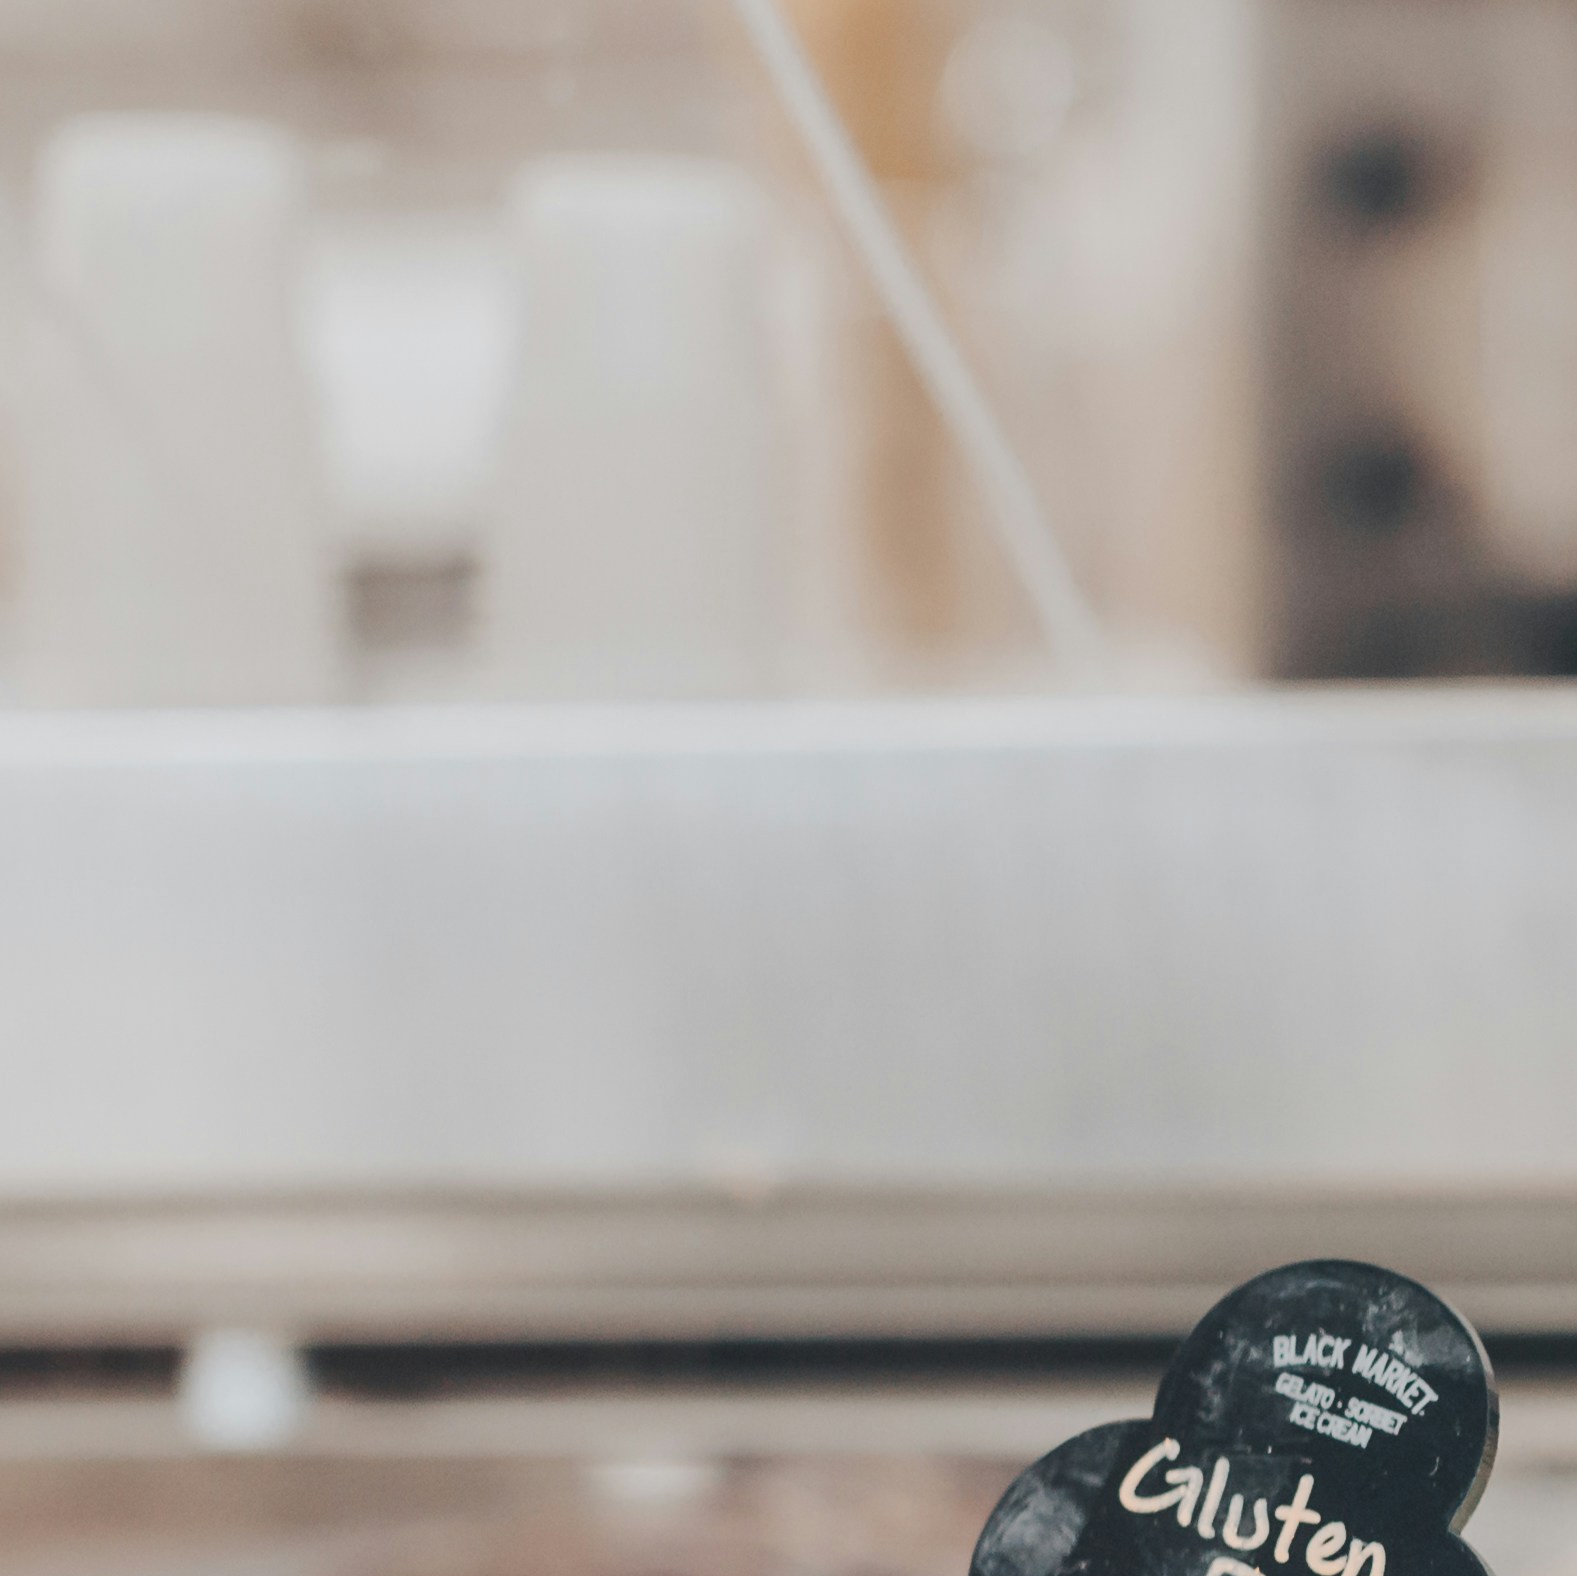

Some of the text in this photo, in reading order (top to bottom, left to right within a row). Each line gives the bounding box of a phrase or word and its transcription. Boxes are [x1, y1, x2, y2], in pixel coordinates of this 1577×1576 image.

[1273, 1333, 1352, 1370] BLACK
[1275, 1372, 1335, 1409] GELATO
[1344, 1397, 1408, 1435] SORBET
[1289, 1401, 1373, 1449] ICE CREAM
